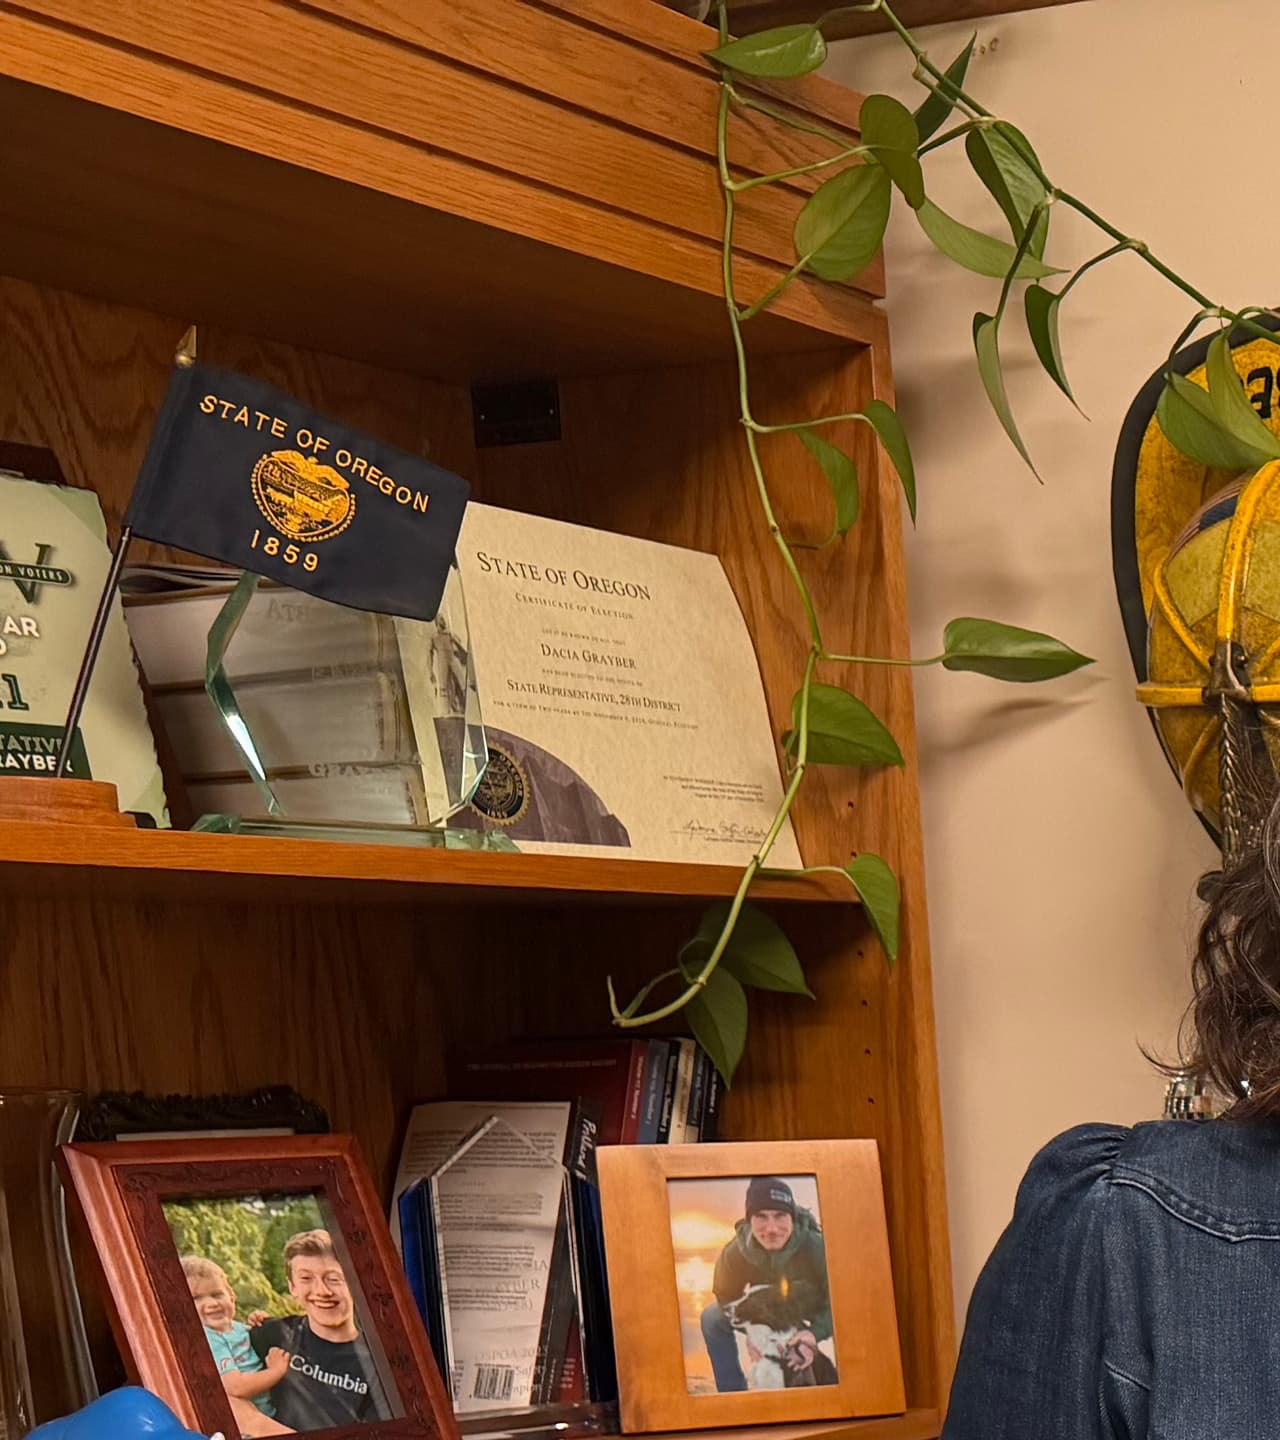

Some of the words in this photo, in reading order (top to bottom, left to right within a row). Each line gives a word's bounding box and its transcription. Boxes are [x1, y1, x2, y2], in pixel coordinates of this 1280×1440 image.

[199, 395, 288, 439] STATE
[296, 428, 330, 454] OF
[335, 449, 430, 513] OREGON
[251, 529, 319, 572] 1859
[17, 566, 63, 581] VOTERS
[477, 552, 541, 582] STATE
[545, 568, 568, 586] OF
[573, 570, 651, 601] OREGON
[582, 650, 637, 670] GRAYBER
[289, 1355, 368, 1394] Columbia
